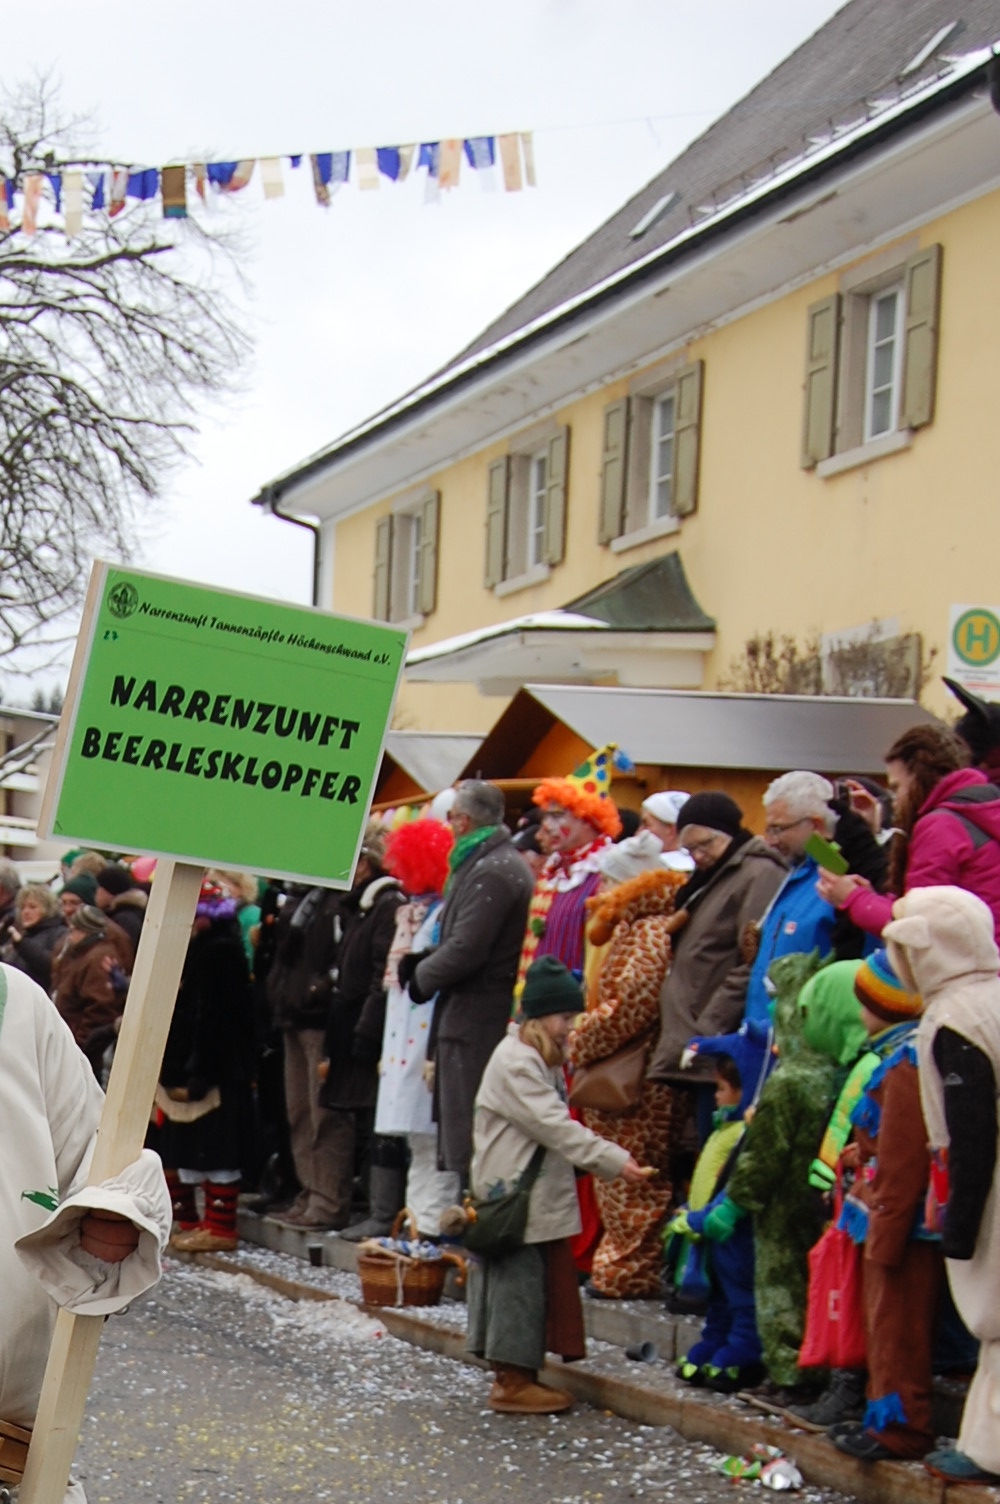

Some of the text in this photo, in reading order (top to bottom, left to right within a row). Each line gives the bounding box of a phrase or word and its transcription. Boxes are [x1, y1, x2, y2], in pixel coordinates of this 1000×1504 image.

[138, 602, 391, 665] Narrenzunft Tannenzäpfle Höchenschwand e.V.
[966, 623, 990, 654] H
[110, 675, 360, 750] NARRENZUNFT
[81, 727, 361, 805] BEERLESKLOPFER
